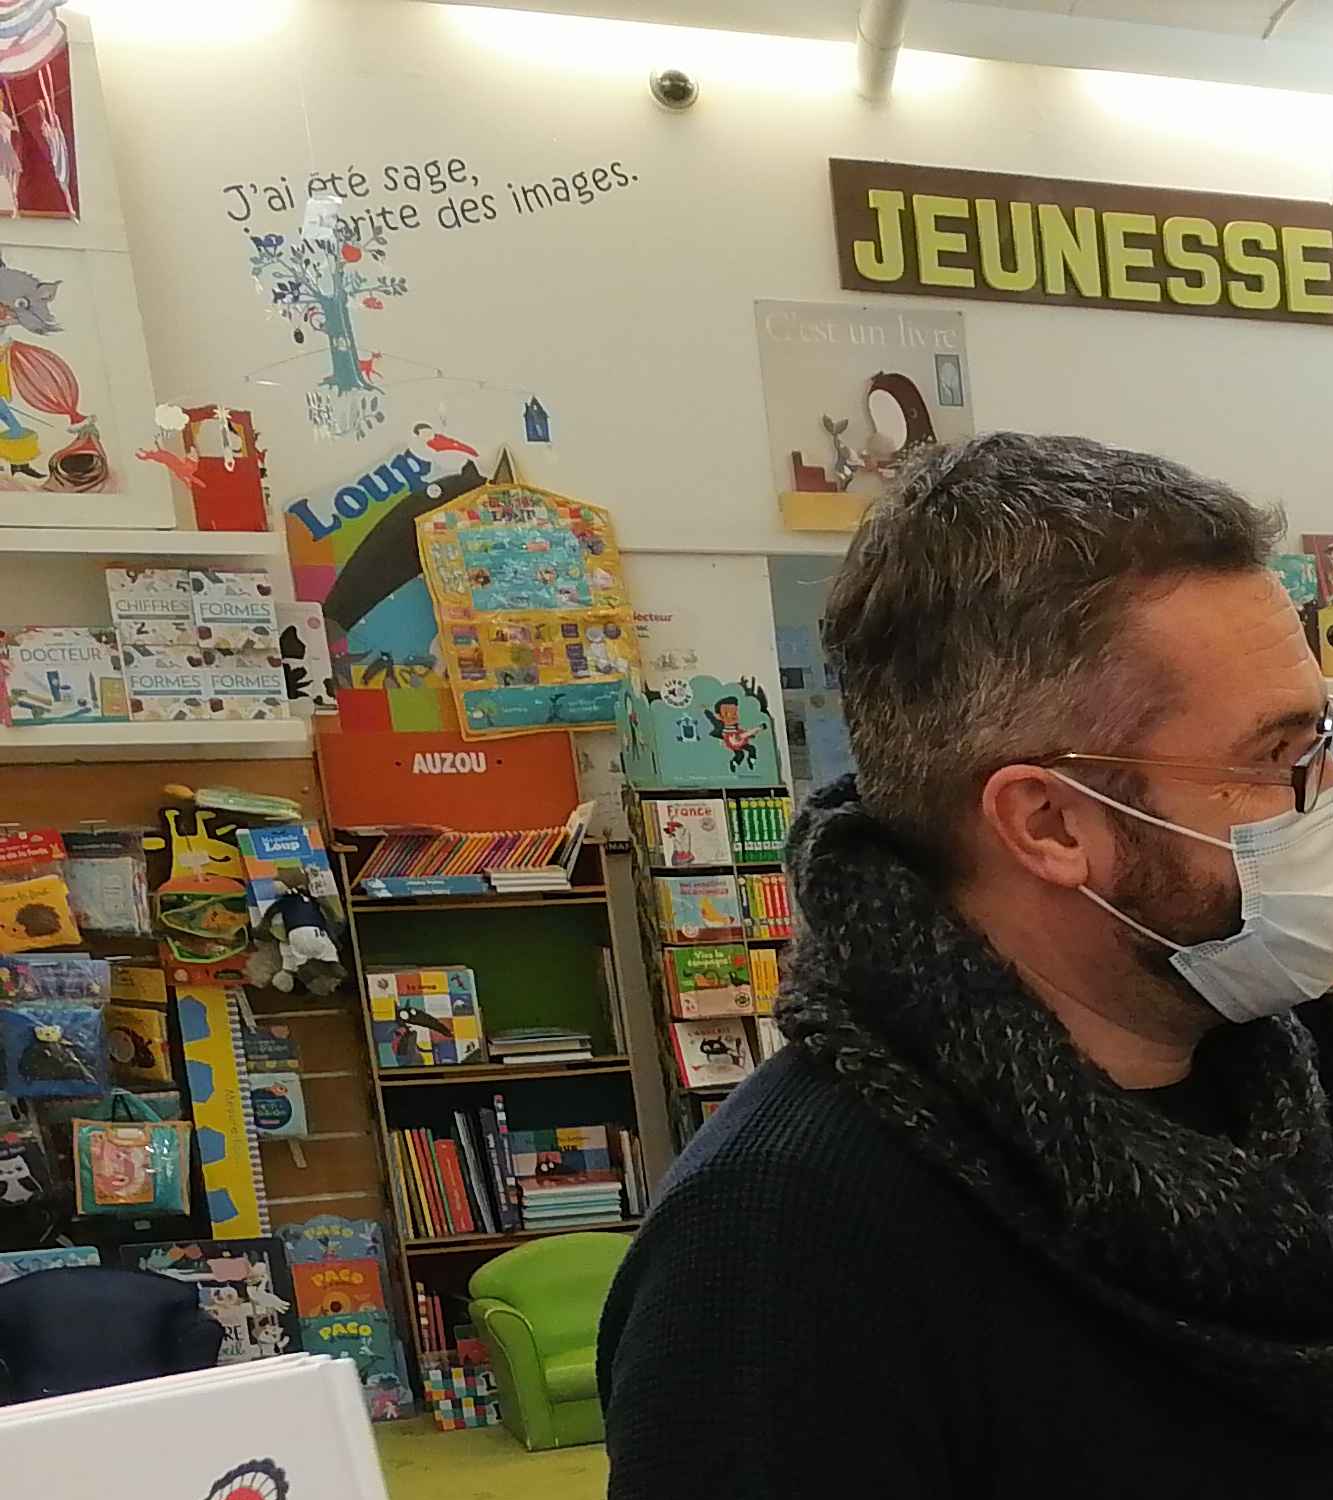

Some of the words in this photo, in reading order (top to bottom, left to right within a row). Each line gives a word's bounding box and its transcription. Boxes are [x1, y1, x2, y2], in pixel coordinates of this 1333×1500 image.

[223, 176, 296, 222] J'ai
[383, 157, 480, 195] sage,
[438, 193, 498, 230] des
[508, 160, 640, 215] images.
[766, 311, 839, 344] C'est
[851, 323, 886, 345] un
[898, 313, 957, 348] livre
[286, 447, 432, 542] Loup
[116, 599, 190, 613] CHIFFRES
[201, 602, 272, 617] FORMES
[20, 648, 102, 663] DOCTEUR
[130, 674, 201, 689] FORMES
[211, 674, 282, 689] FORMES
[412, 751, 488, 775] AUZOU
[667, 805, 713, 818] France
[310, 1270, 365, 1288] PACO
[319, 1323, 373, 1341] PACO
